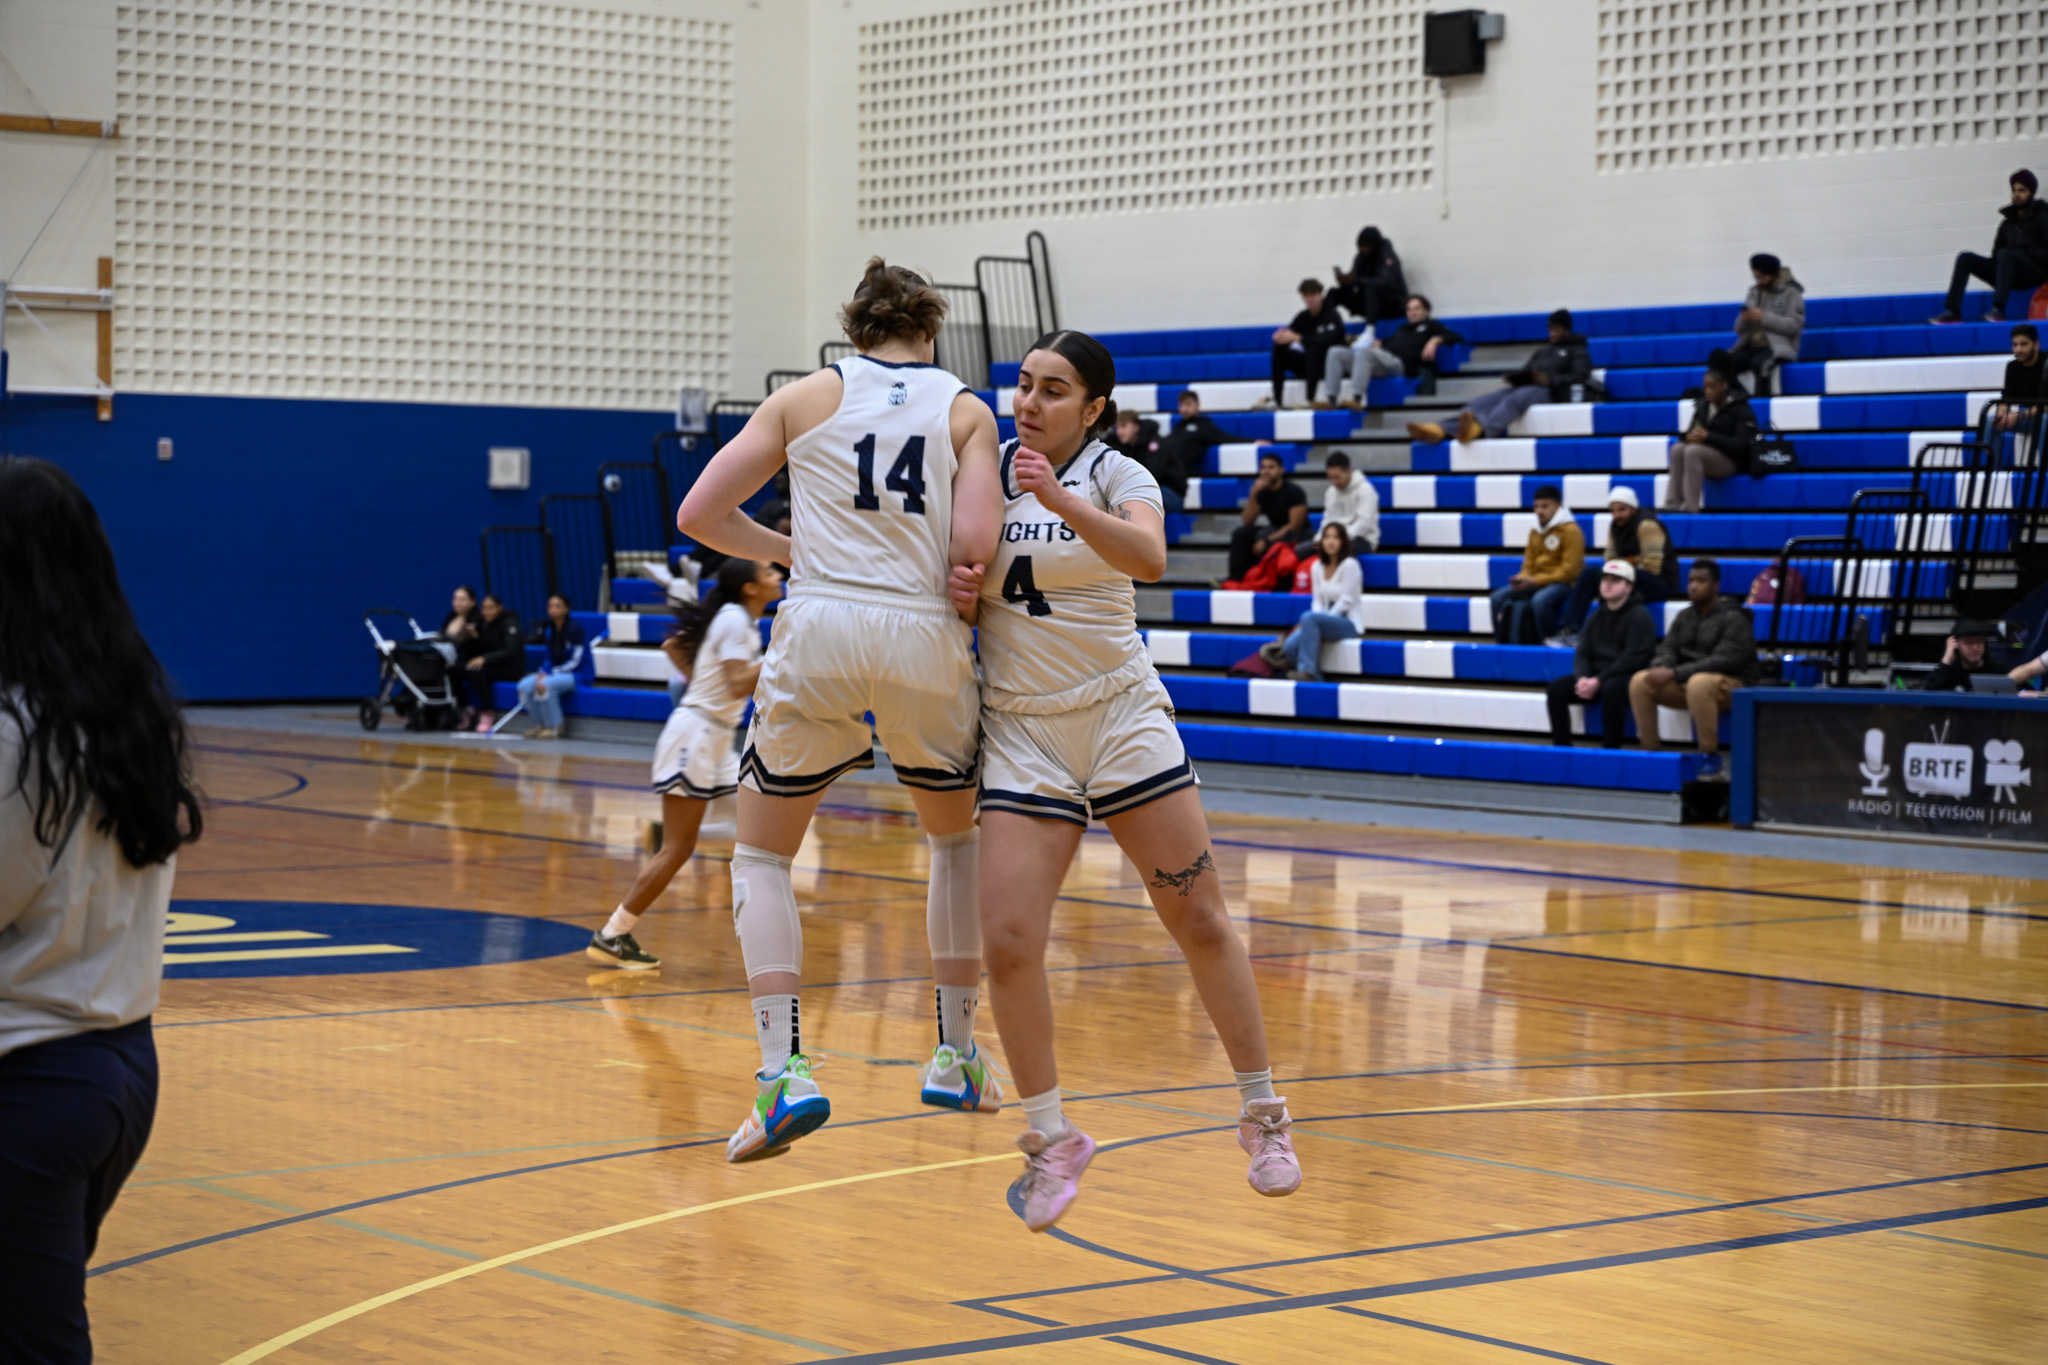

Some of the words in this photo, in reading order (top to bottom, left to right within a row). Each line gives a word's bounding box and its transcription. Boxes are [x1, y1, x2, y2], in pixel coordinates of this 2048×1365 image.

[853, 432, 926, 516] 14
[999, 521, 1076, 544] IGHTS
[1001, 555, 1053, 617] 4
[1909, 757, 1966, 779] BRTF
[1848, 799, 1892, 816] RADIO
[1905, 802, 1985, 822] TELEVISION
[1999, 808, 2033, 825] FILM
